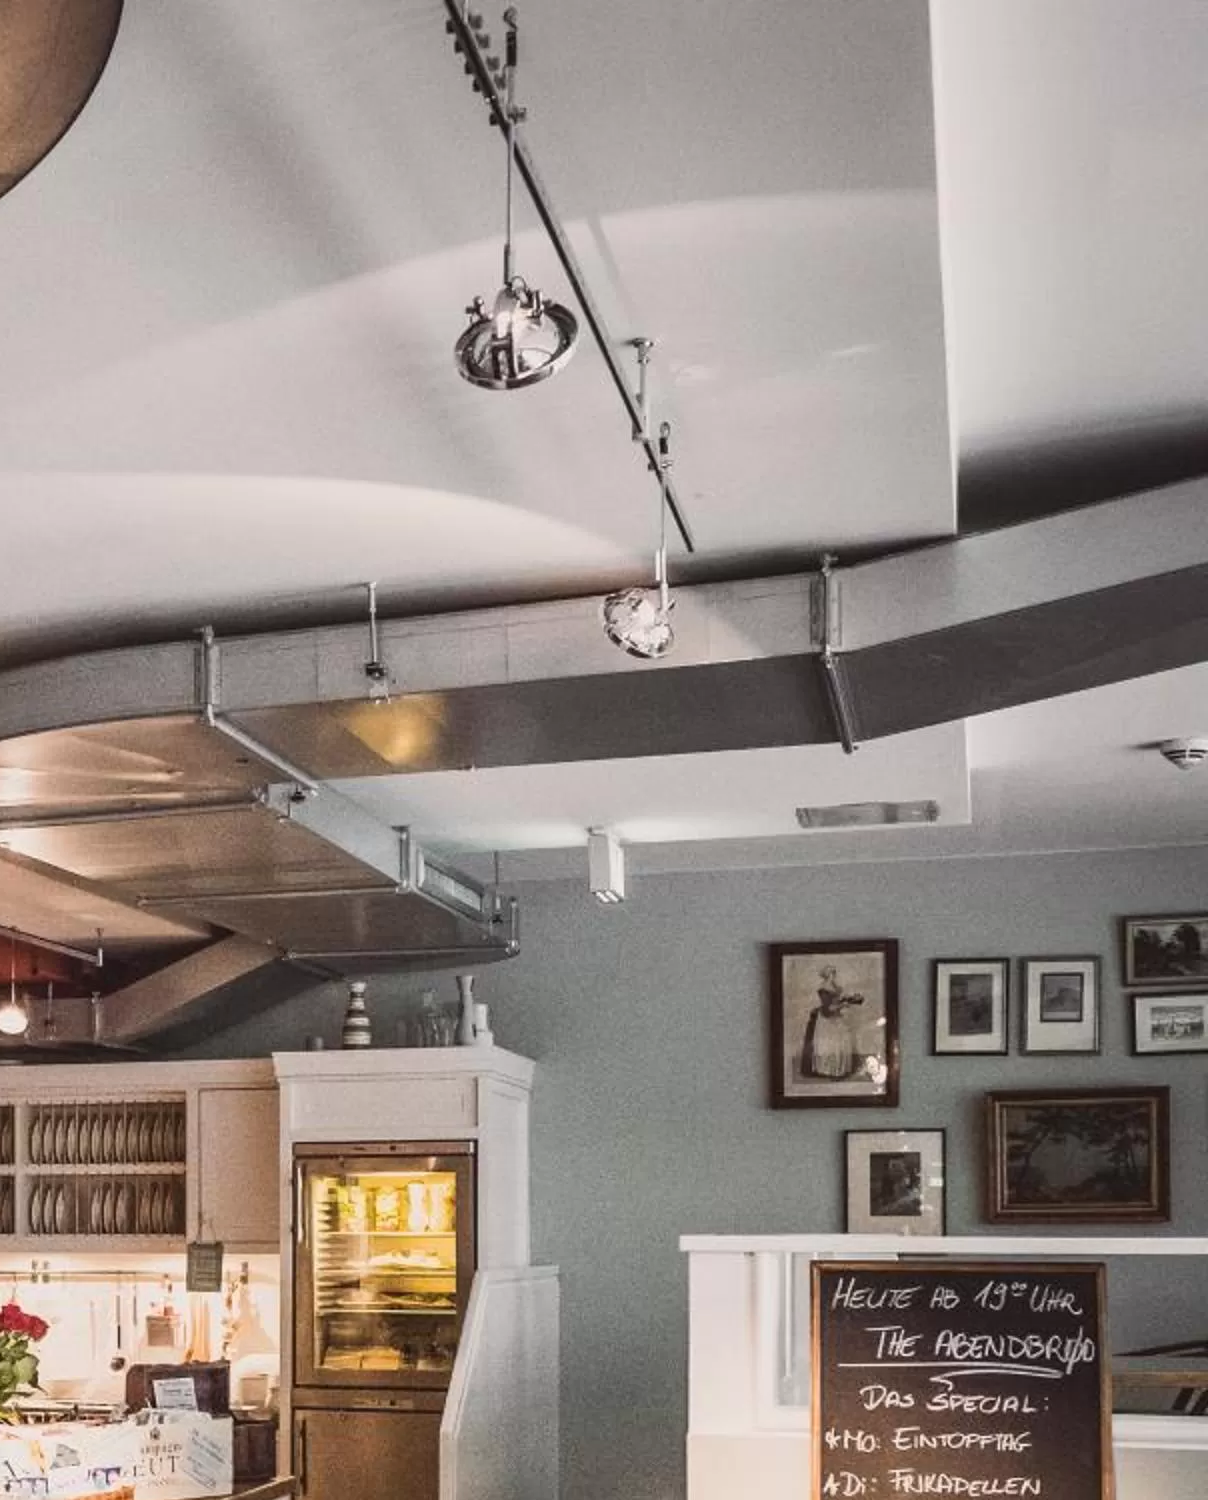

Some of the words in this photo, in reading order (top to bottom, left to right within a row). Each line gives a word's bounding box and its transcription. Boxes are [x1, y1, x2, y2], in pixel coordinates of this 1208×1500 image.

[831, 1277, 921, 1310] HEUTE
[930, 1286, 960, 1310] AB
[1030, 1286, 1083, 1315] UHR
[865, 1325, 924, 1359] THE
[860, 1385, 914, 1411] DAS
[888, 1467, 1041, 1497] FRIKADELLEN
